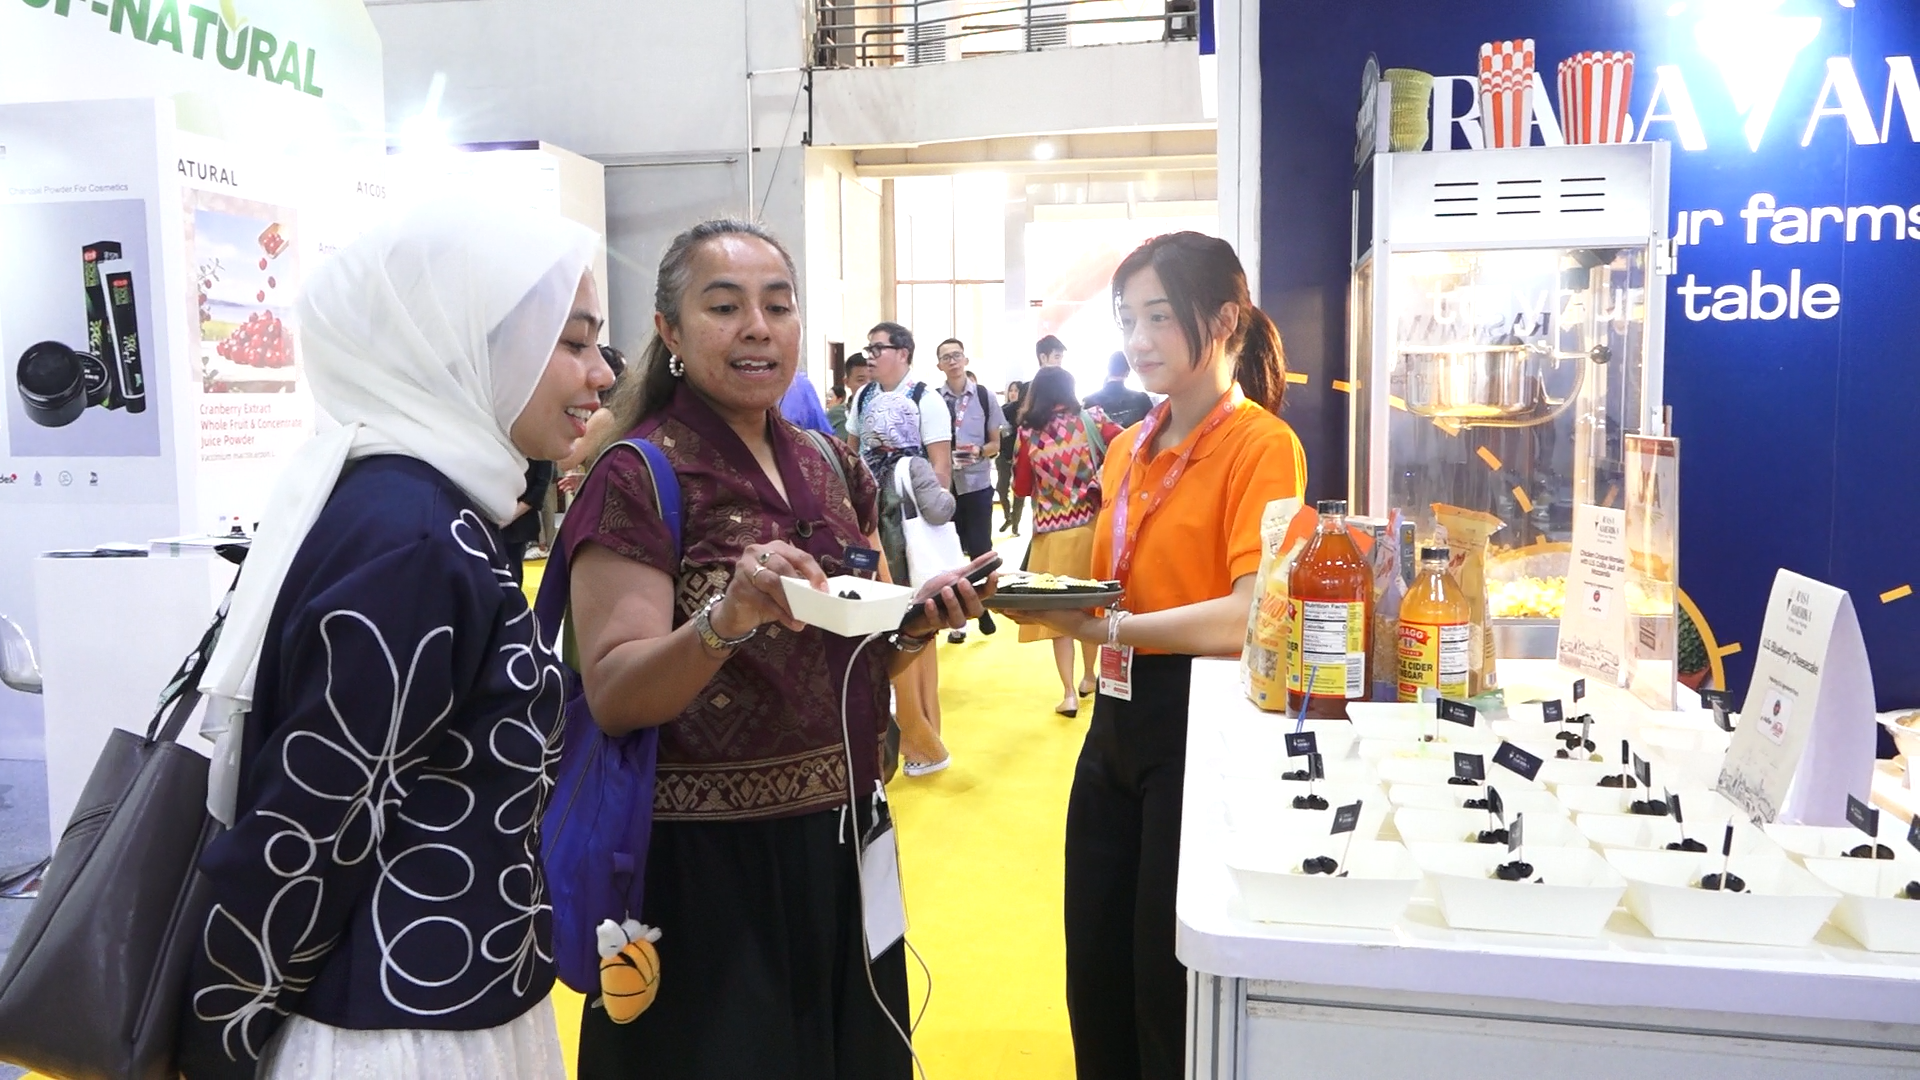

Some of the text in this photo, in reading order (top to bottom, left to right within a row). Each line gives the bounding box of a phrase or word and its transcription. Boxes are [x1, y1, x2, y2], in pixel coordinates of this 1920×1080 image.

[22, 0, 323, 98] -NATURAL
[1678, 269, 1840, 322] table
[200, 404, 271, 416] Cranberry Extract
[201, 420, 228, 430] Whole
[230, 419, 249, 430] Fruit
[201, 435, 254, 449] Juice Powder
[1408, 661, 1433, 672] CIDER
